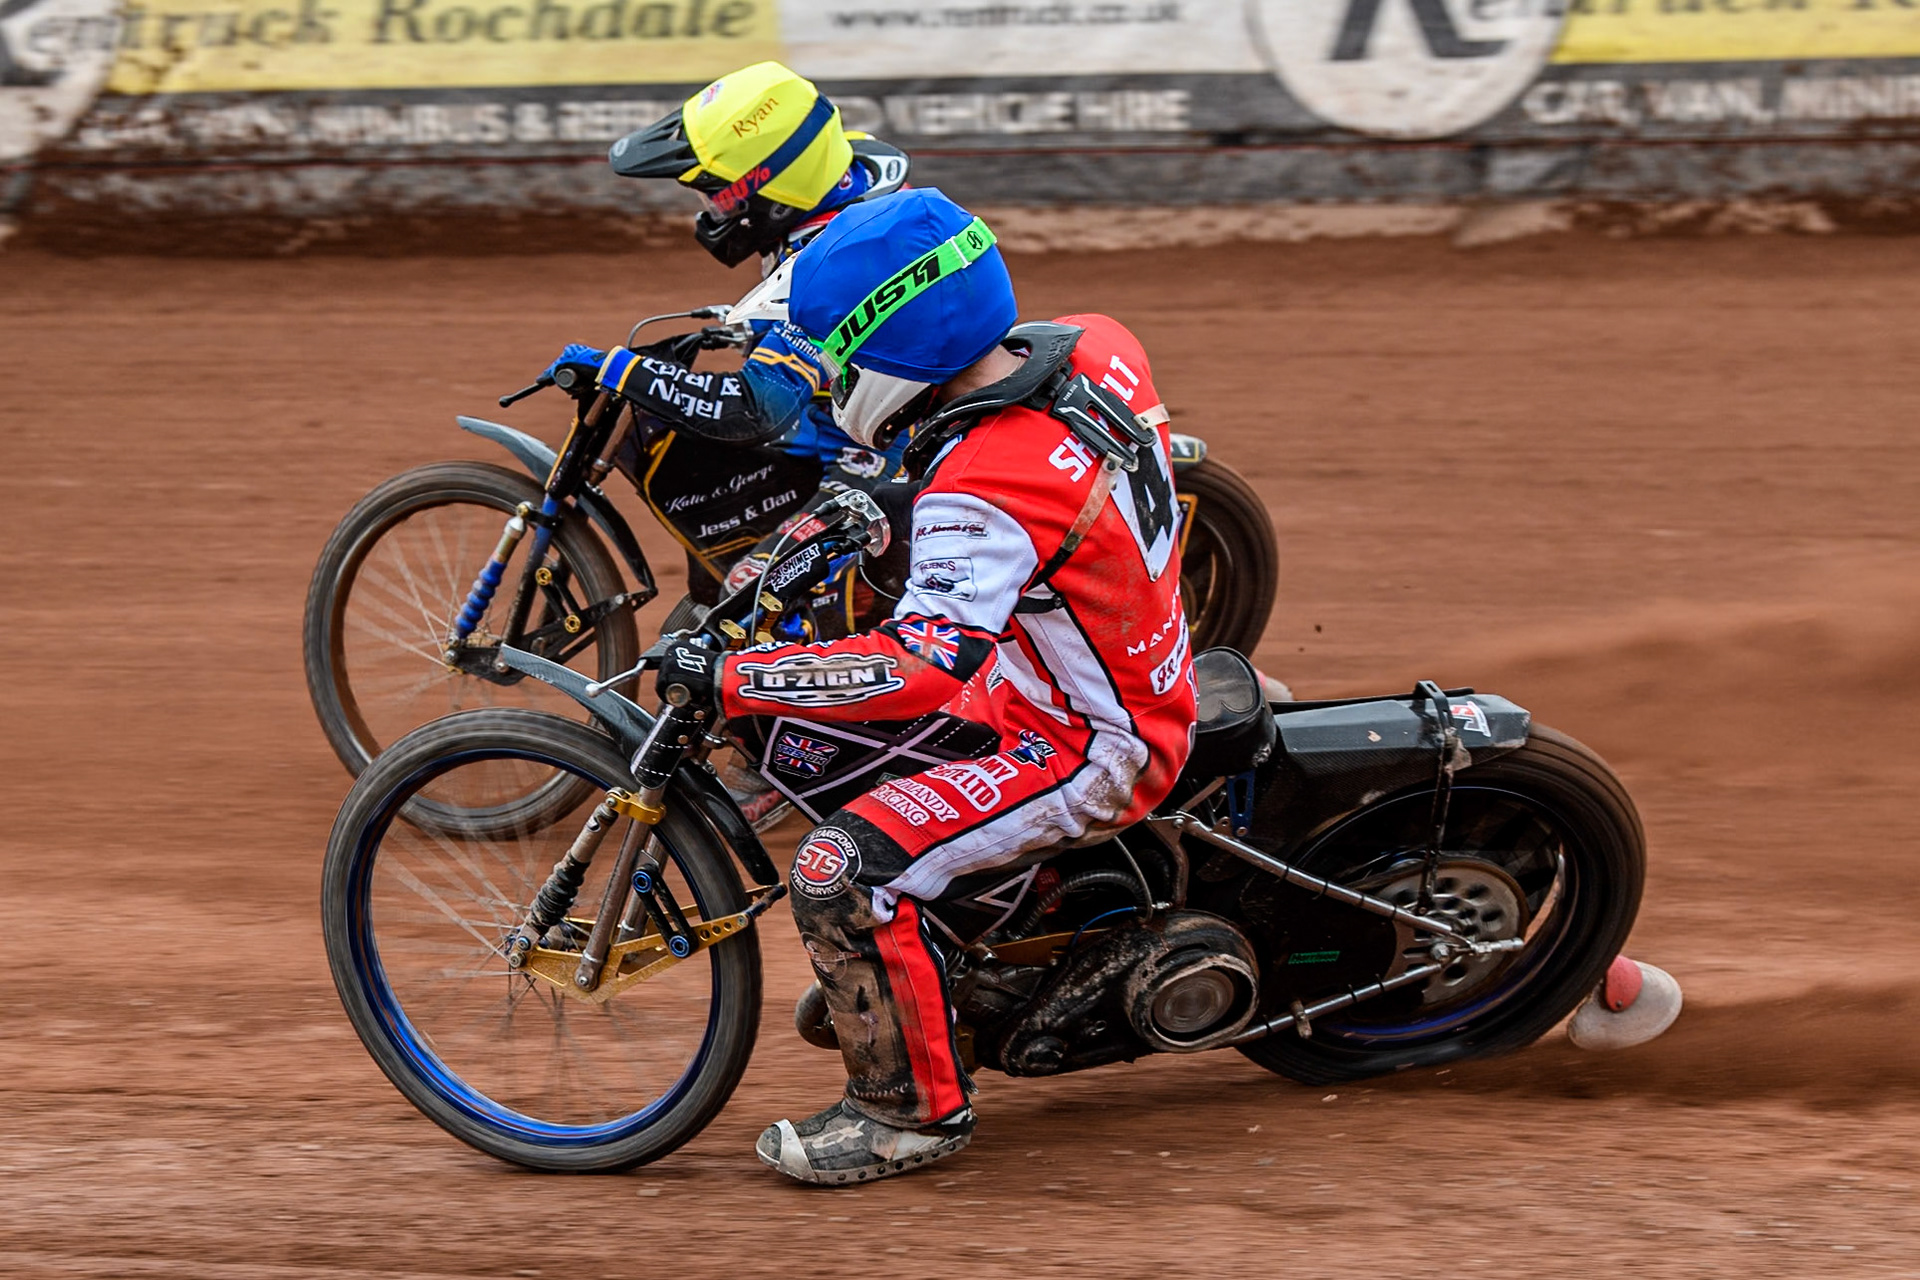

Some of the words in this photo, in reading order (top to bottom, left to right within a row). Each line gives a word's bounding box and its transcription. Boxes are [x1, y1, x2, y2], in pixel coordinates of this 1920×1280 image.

[371, 0, 755, 44] Rochdale
[732, 96, 779, 138] Ryan
[712, 166, 771, 213] 100%
[647, 377, 724, 420] Nigel
[720, 376, 743, 397] &
[1048, 354, 1140, 483] SHLT
[665, 494, 708, 514] Katie
[729, 463, 775, 494] George
[1126, 444, 1175, 553] 4
[696, 515, 741, 539] Jess
[744, 505, 760, 521] &
[762, 488, 798, 513] Dan
[782, 544, 820, 573] SHIMELT
[872, 785, 929, 825] RACING
[959, 773, 997, 807] LTD
[797, 844, 846, 876] STS
[791, 867, 806, 890] TYRE
[804, 882, 843, 896] SERVICES
